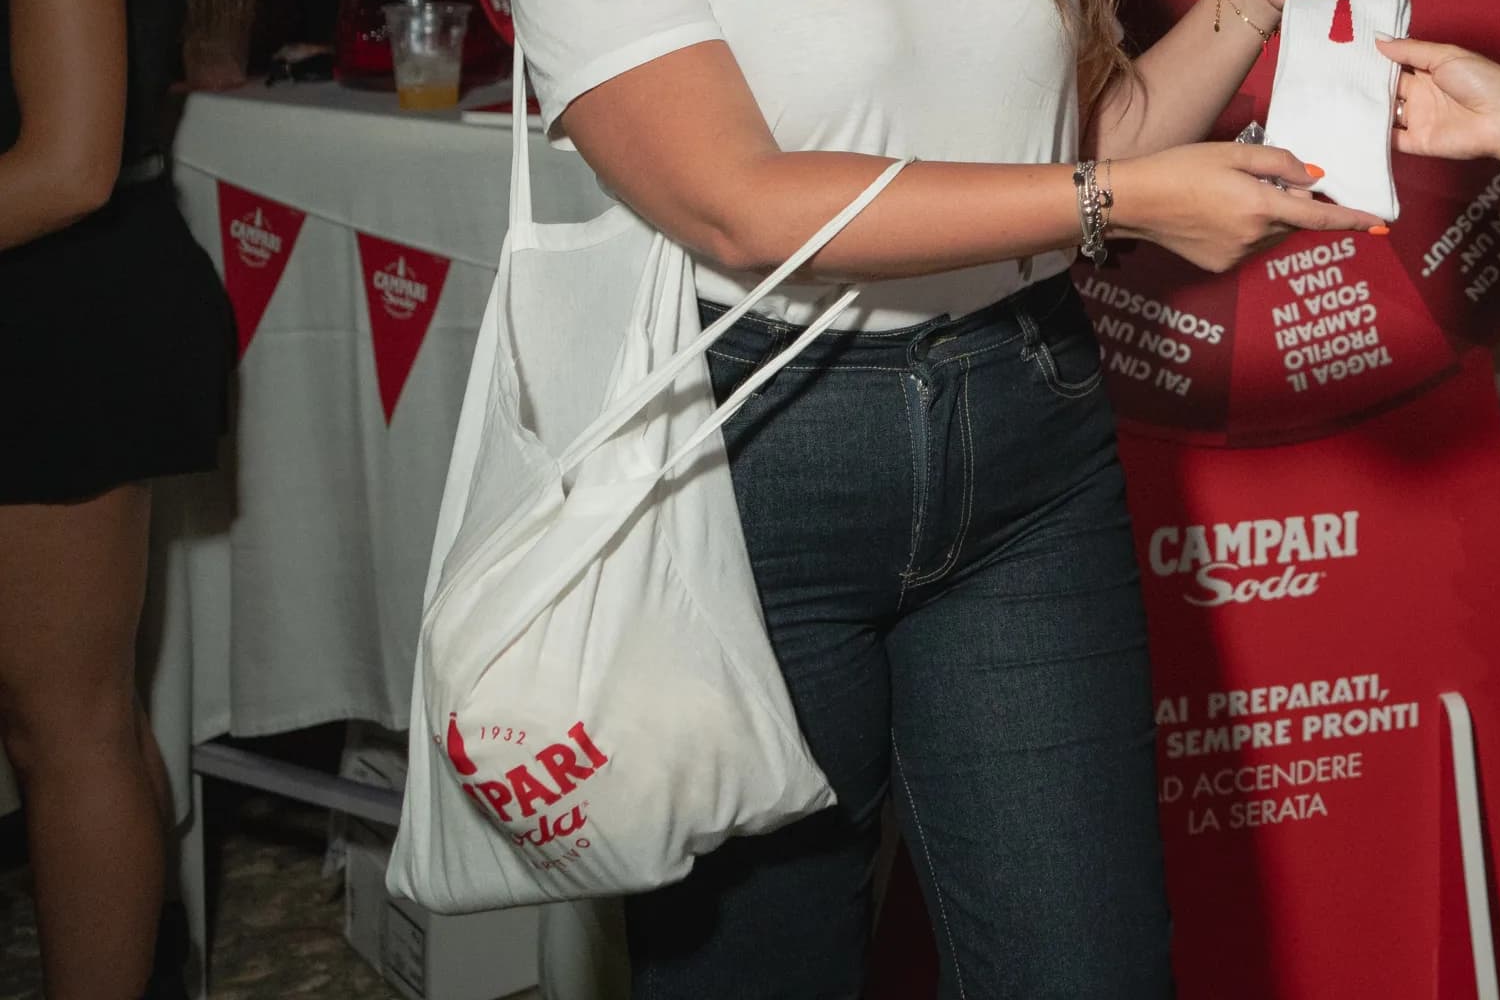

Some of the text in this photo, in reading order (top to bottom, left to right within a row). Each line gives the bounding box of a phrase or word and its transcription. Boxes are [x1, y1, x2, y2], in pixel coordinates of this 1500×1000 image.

[1266, 237, 1356, 280] STORIA!
[1288, 266, 1343, 296] UNA
[1464, 265, 1499, 302] CIN
[1272, 281, 1370, 327] SODA IN
[1138, 330, 1191, 364] CON
[1275, 304, 1377, 350] CAMPARI
[1284, 326, 1379, 369] PROFILO
[1110, 351, 1151, 380] CIN
[1155, 368, 1192, 397] FAI
[1286, 346, 1392, 392] TAGGA IL
[1150, 510, 1359, 576] CAMPARI
[1184, 562, 1320, 607] Soda
[1208, 673, 1390, 719] PREPARATI,
[480, 725, 526, 745] 1932
[1166, 702, 1419, 759] SEMPRE PRONTI
[463, 721, 608, 822] PARI
[1160, 752, 1362, 804] D ACCENDERE
[511, 805, 587, 847] oda
[1188, 793, 1328, 835] LA SERATA
